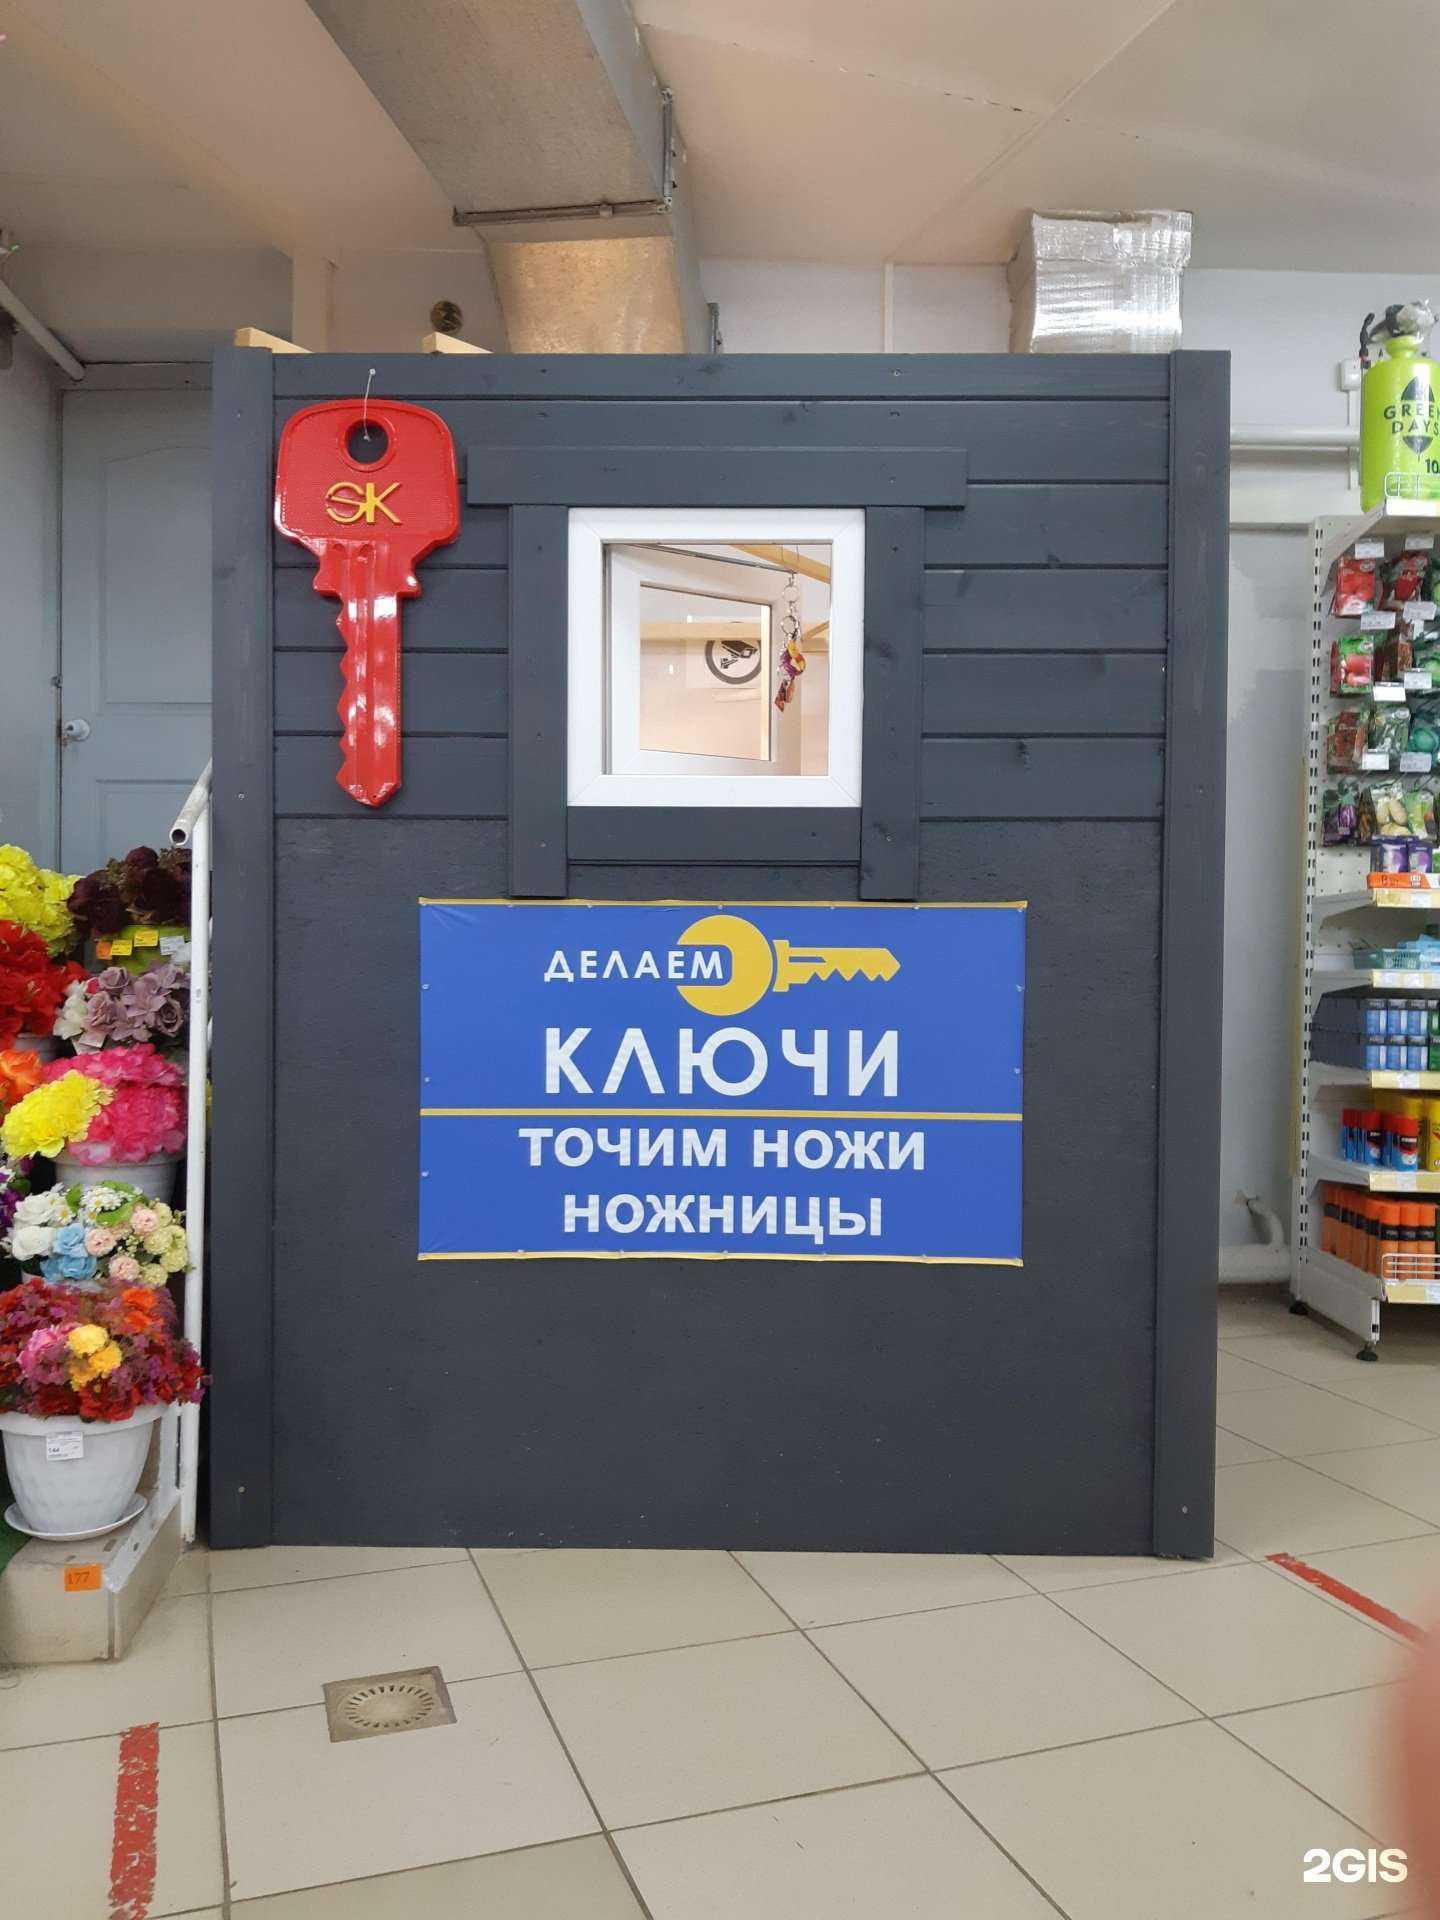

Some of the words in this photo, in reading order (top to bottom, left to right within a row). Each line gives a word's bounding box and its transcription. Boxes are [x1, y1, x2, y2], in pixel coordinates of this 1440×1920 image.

[1391, 418, 1439, 436] DAYS
[326, 482, 401, 524] SK
[544, 950, 724, 983] ДЕЛАЕМ
[544, 1027, 899, 1097] КЛЮЧИ
[518, 1128, 727, 1167] ТОЧИМ
[753, 1129, 925, 1170] НОЖИ
[563, 1194, 882, 1244] НОЖНИЦЫ
